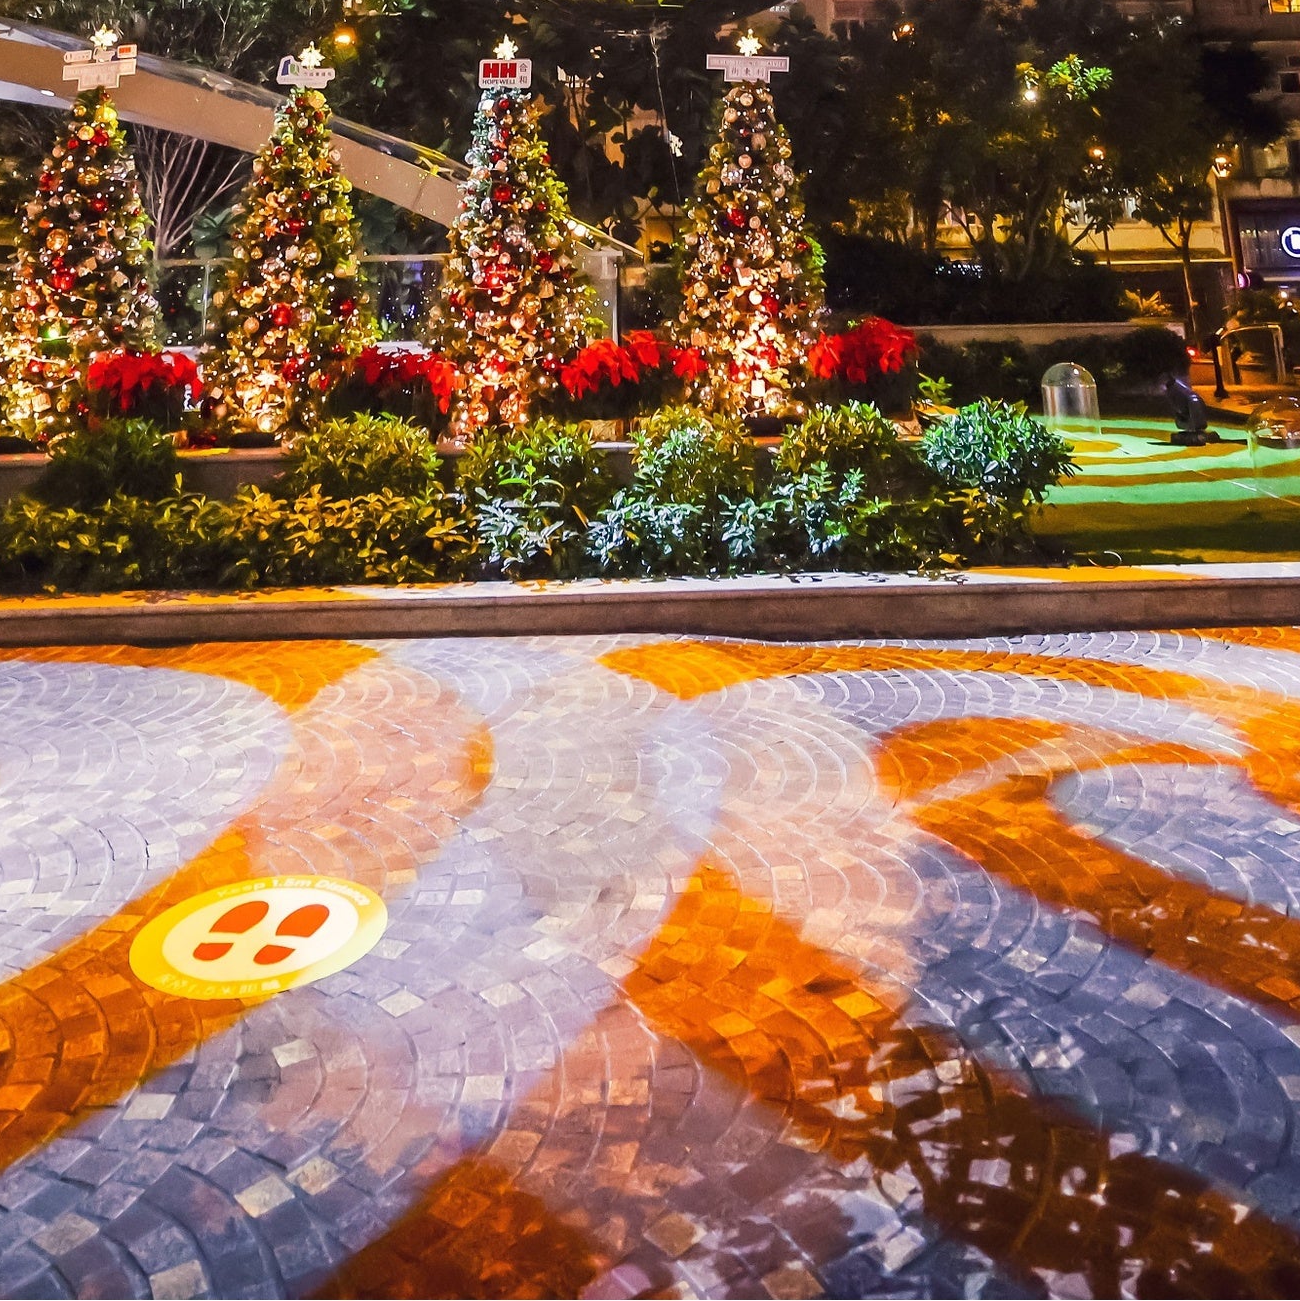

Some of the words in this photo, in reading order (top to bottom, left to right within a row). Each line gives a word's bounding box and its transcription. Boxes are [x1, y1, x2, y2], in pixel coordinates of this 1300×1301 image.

[483, 62, 517, 78] HH
[218, 881, 266, 899] Keep
[271, 878, 312, 889] 1.5m
